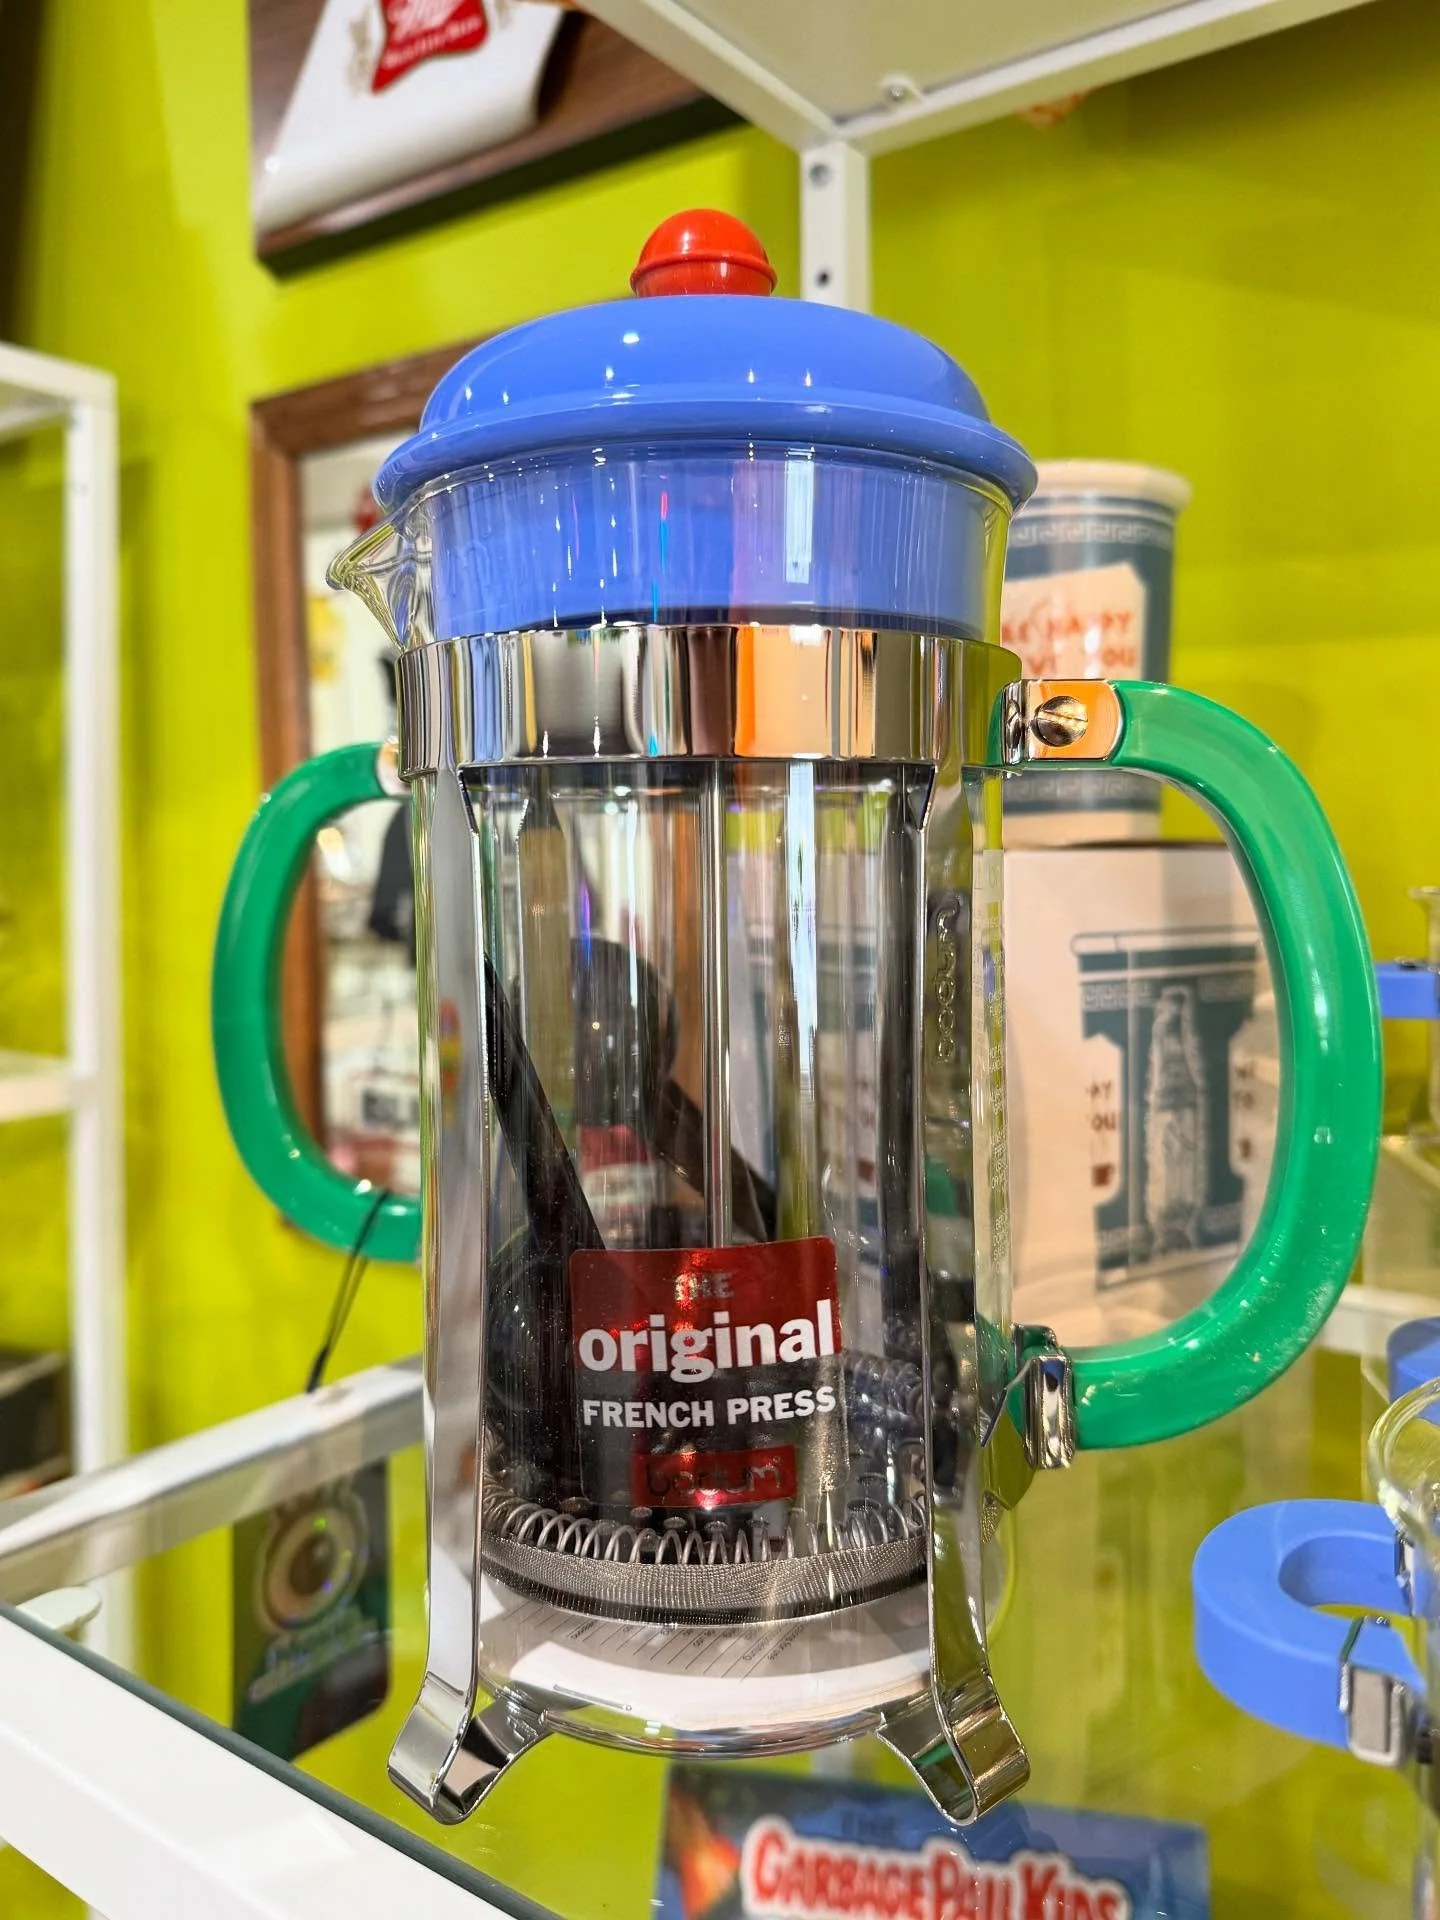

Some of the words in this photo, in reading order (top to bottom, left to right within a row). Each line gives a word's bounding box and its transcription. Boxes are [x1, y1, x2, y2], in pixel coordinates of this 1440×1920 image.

[578, 1298, 836, 1383] original
[582, 1399, 715, 1428] FRENCH
[726, 1386, 837, 1425] PRESS
